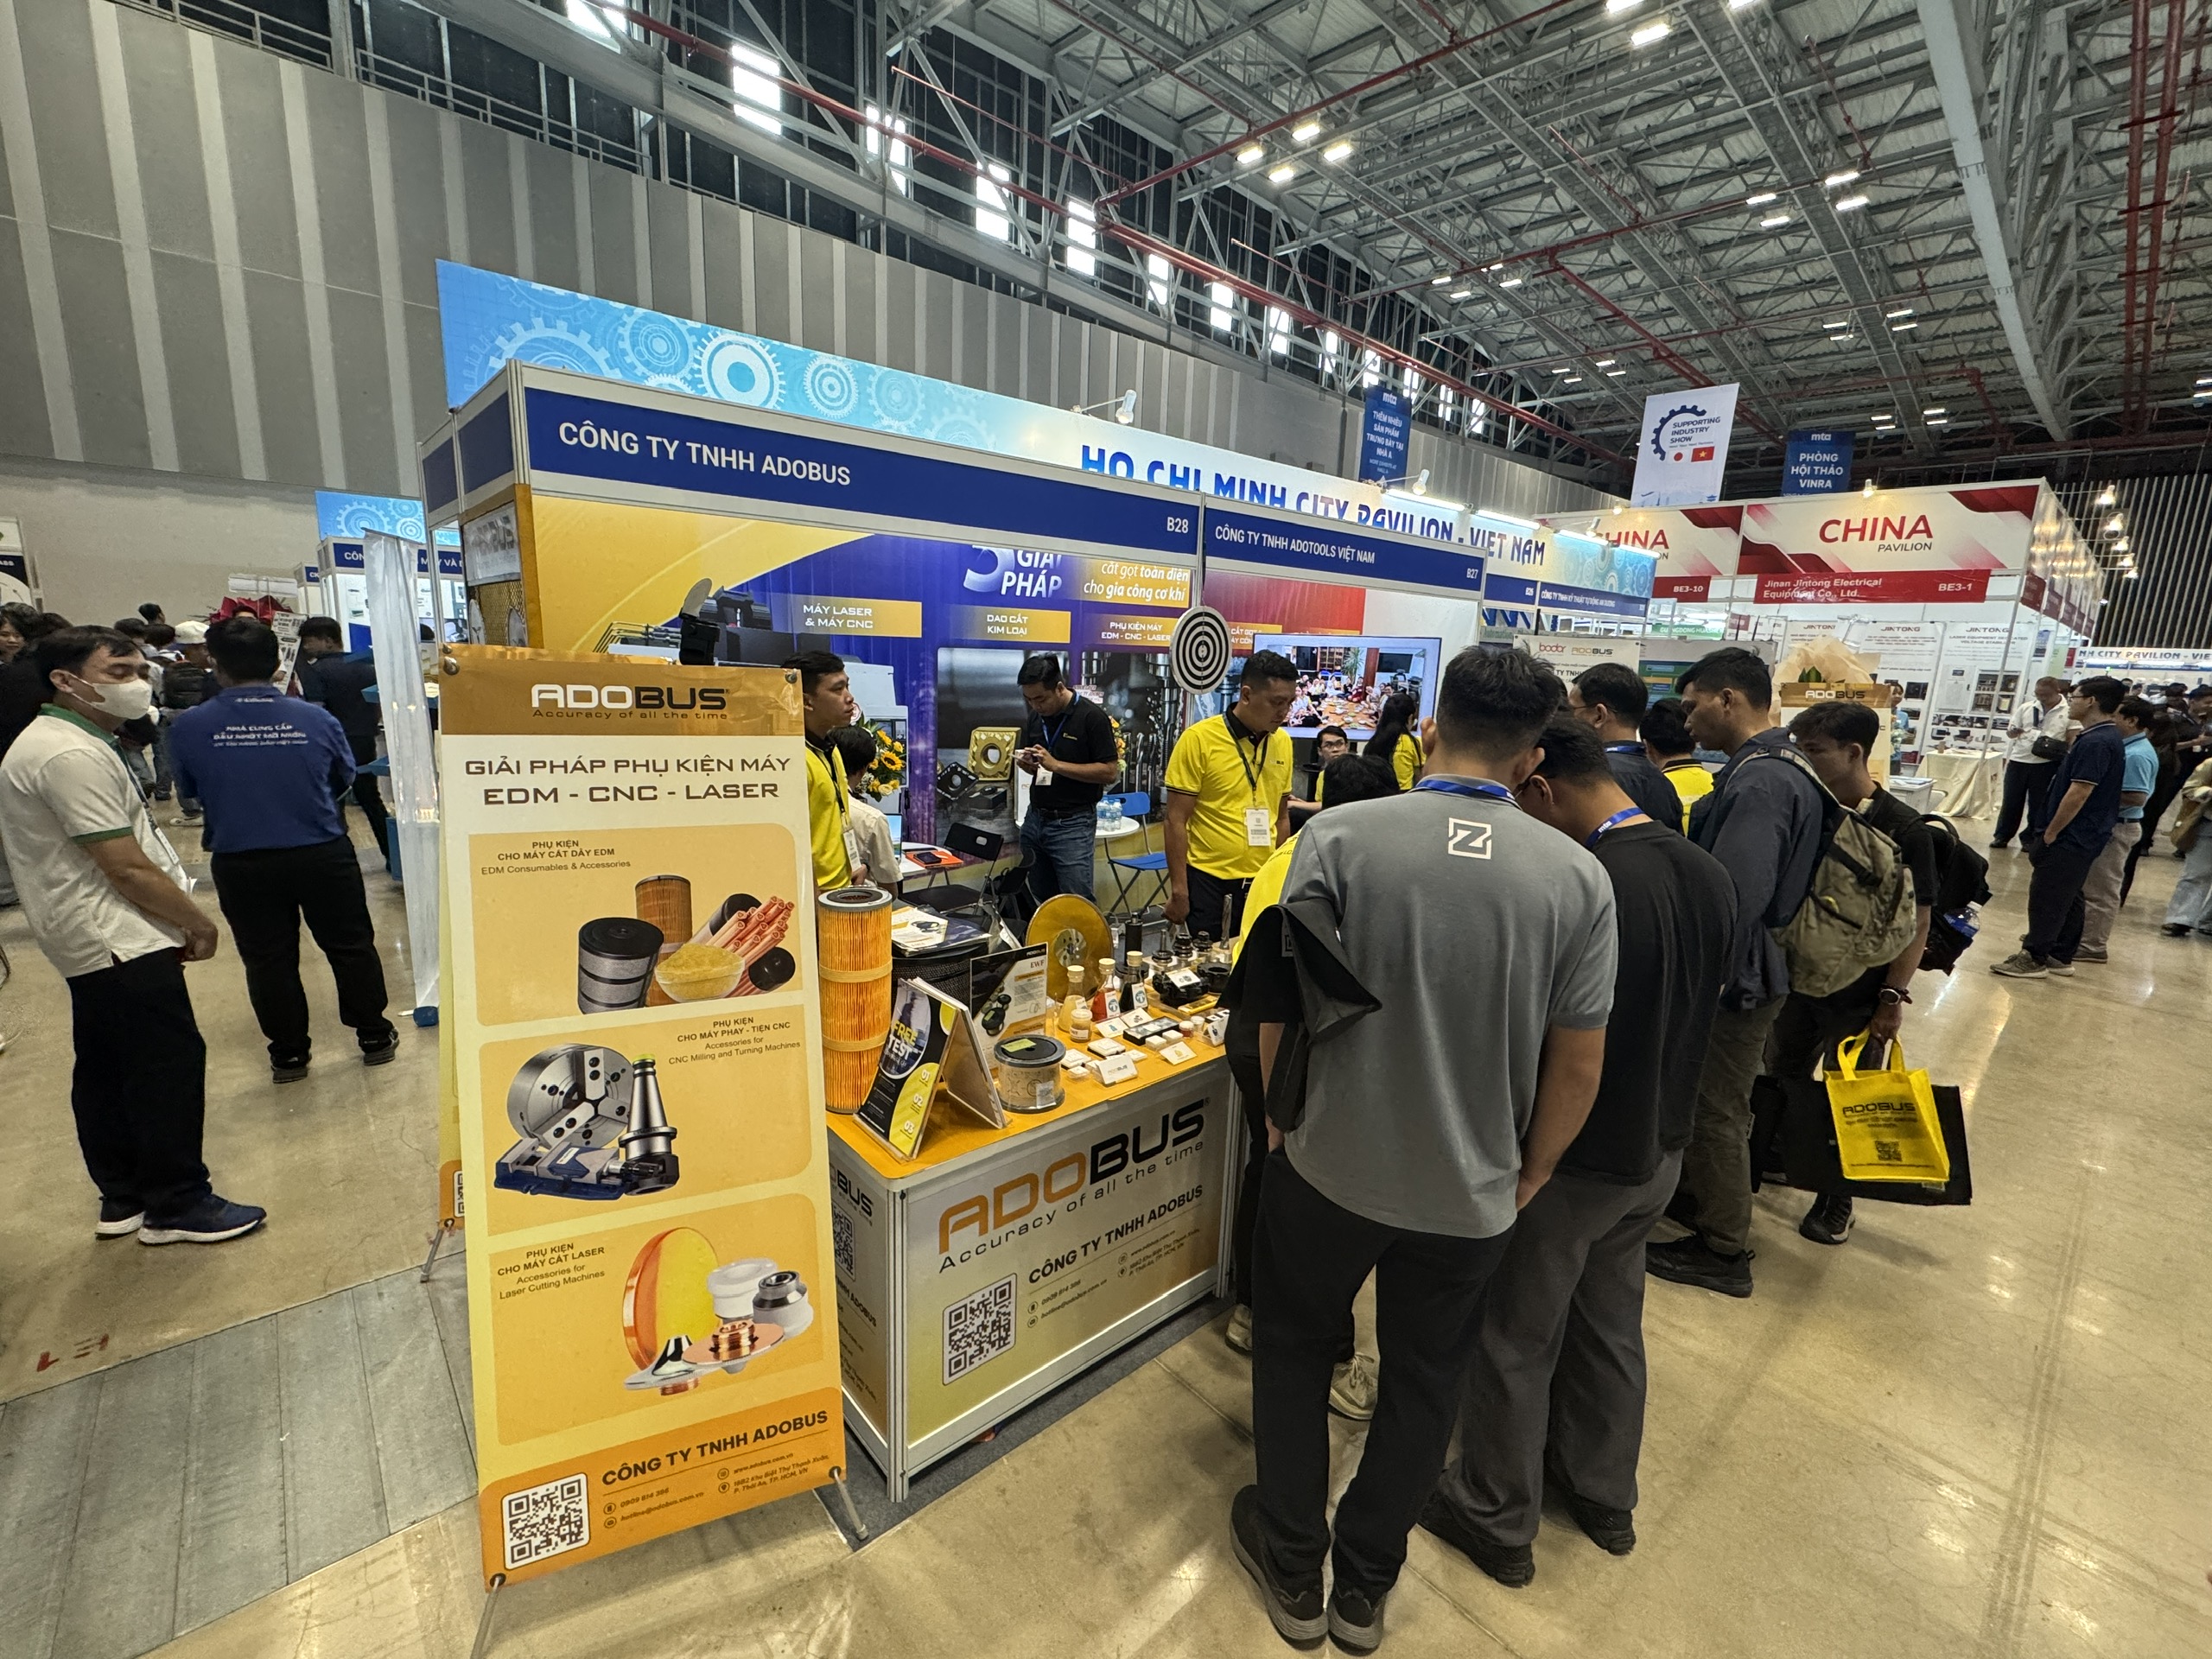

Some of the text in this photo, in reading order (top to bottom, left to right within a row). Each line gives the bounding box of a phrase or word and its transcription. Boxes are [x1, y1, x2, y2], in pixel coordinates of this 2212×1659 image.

[1382, 392, 1397, 405] mta
[1373, 410, 1388, 423] THÊM
[1673, 416, 1720, 429] SUPPORTING
[1671, 426, 1710, 435] INDUSTRY
[1669, 435, 1693, 444] SHOW
[559, 420, 852, 486] CÔNG TY TNHH ADOBUS
[1799, 451, 1839, 462] PHÒNG
[1790, 464, 1843, 476] HỘI THẢO
[1799, 479, 1833, 488] VINRA
[1166, 517, 1189, 534] B28
[1214, 474, 1287, 511] MINH
[1296, 492, 1350, 520] CITY
[1357, 504, 1454, 542] PAVILION
[1512, 537, 1547, 566] NAM
[1819, 514, 1934, 544] CHINA
[1216, 524, 1376, 565] CÔNG TY TNHH ADOTOOLS VIỆT NAM
[1877, 542, 1933, 553] PAVILION
[344, 550, 457, 568] CÔN VÀ
[1121, 563, 1138, 578] gọt
[1141, 564, 1165, 580] toàn
[1166, 568, 1189, 583] diện
[1466, 568, 1478, 580] B27
[1001, 570, 1063, 598] PHÁP
[1084, 580, 1185, 601] cho gia công cơ khí
[1793, 579, 1831, 589] Jintong
[1833, 578, 1882, 588] Electrical
[1938, 582, 1973, 592] BE3-1
[804, 602, 873, 617] MÁY LASER
[805, 617, 874, 629] & MÁY CNC
[987, 613, 1028, 624] DAO CẮT
[1109, 620, 1163, 632] PHỤ KIỆN MÁY
[987, 626, 1027, 636] KIM LOẠI
[1102, 632, 1119, 640] EDM
[1147, 633, 1171, 642] LASER
[531, 683, 728, 709] ADOBUS
[1805, 690, 1866, 699] ADOBUS
[532, 709, 728, 721] Accuracy of all the time
[465, 753, 791, 777] GIẢI PHÁP PHỤ KIỆN MÁY
[484, 783, 779, 806] EDM CNC LASER
[531, 839, 579, 851] PHỤ KIỆN
[498, 852, 520, 861] CHO
[523, 849, 546, 860] MÁY
[570, 848, 592, 858] DÂY
[594, 848, 615, 857] EDM
[481, 860, 631, 875] EDM Consumables & Accessories
[1030, 959, 1045, 969] EWF
[713, 1017, 753, 1029] PHỤ KIỆN
[677, 1021, 791, 1042] CHO MÁY PHAY TIỆN CNC
[893, 1020, 918, 1046] FREE
[705, 1039, 751, 1050] Accessories
[888, 1033, 912, 1061] TEST
[669, 1041, 800, 1065] CNC Milling and Turning Machines
[921, 1069, 931, 1082] 01
[913, 1093, 924, 1108] 02
[1842, 1103, 1916, 1116] ADOBUS
[904, 1120, 914, 1135] 03
[938, 1098, 1205, 1255] ADOBUS
[939, 1141, 1204, 1274] Accuracy of all the time
[1029, 1250, 1077, 1284] CÔNG
[1082, 1236, 1103, 1263] TY
[1105, 1214, 1145, 1250] TNHH
[1147, 1185, 1204, 1224] ADOBUS
[526, 1243, 574, 1260] PHỤ KIỆN
[498, 1265, 520, 1276] CHO
[524, 1258, 545, 1270] MÁY
[571, 1247, 605, 1260] LASER
[516, 1264, 586, 1285] Accessories for
[499, 1271, 605, 1300] Laser Cutting Machines
[602, 1410, 829, 1486] CÔNG TY TNHH ADOBUS
[620, 1496, 640, 1508] 0909
